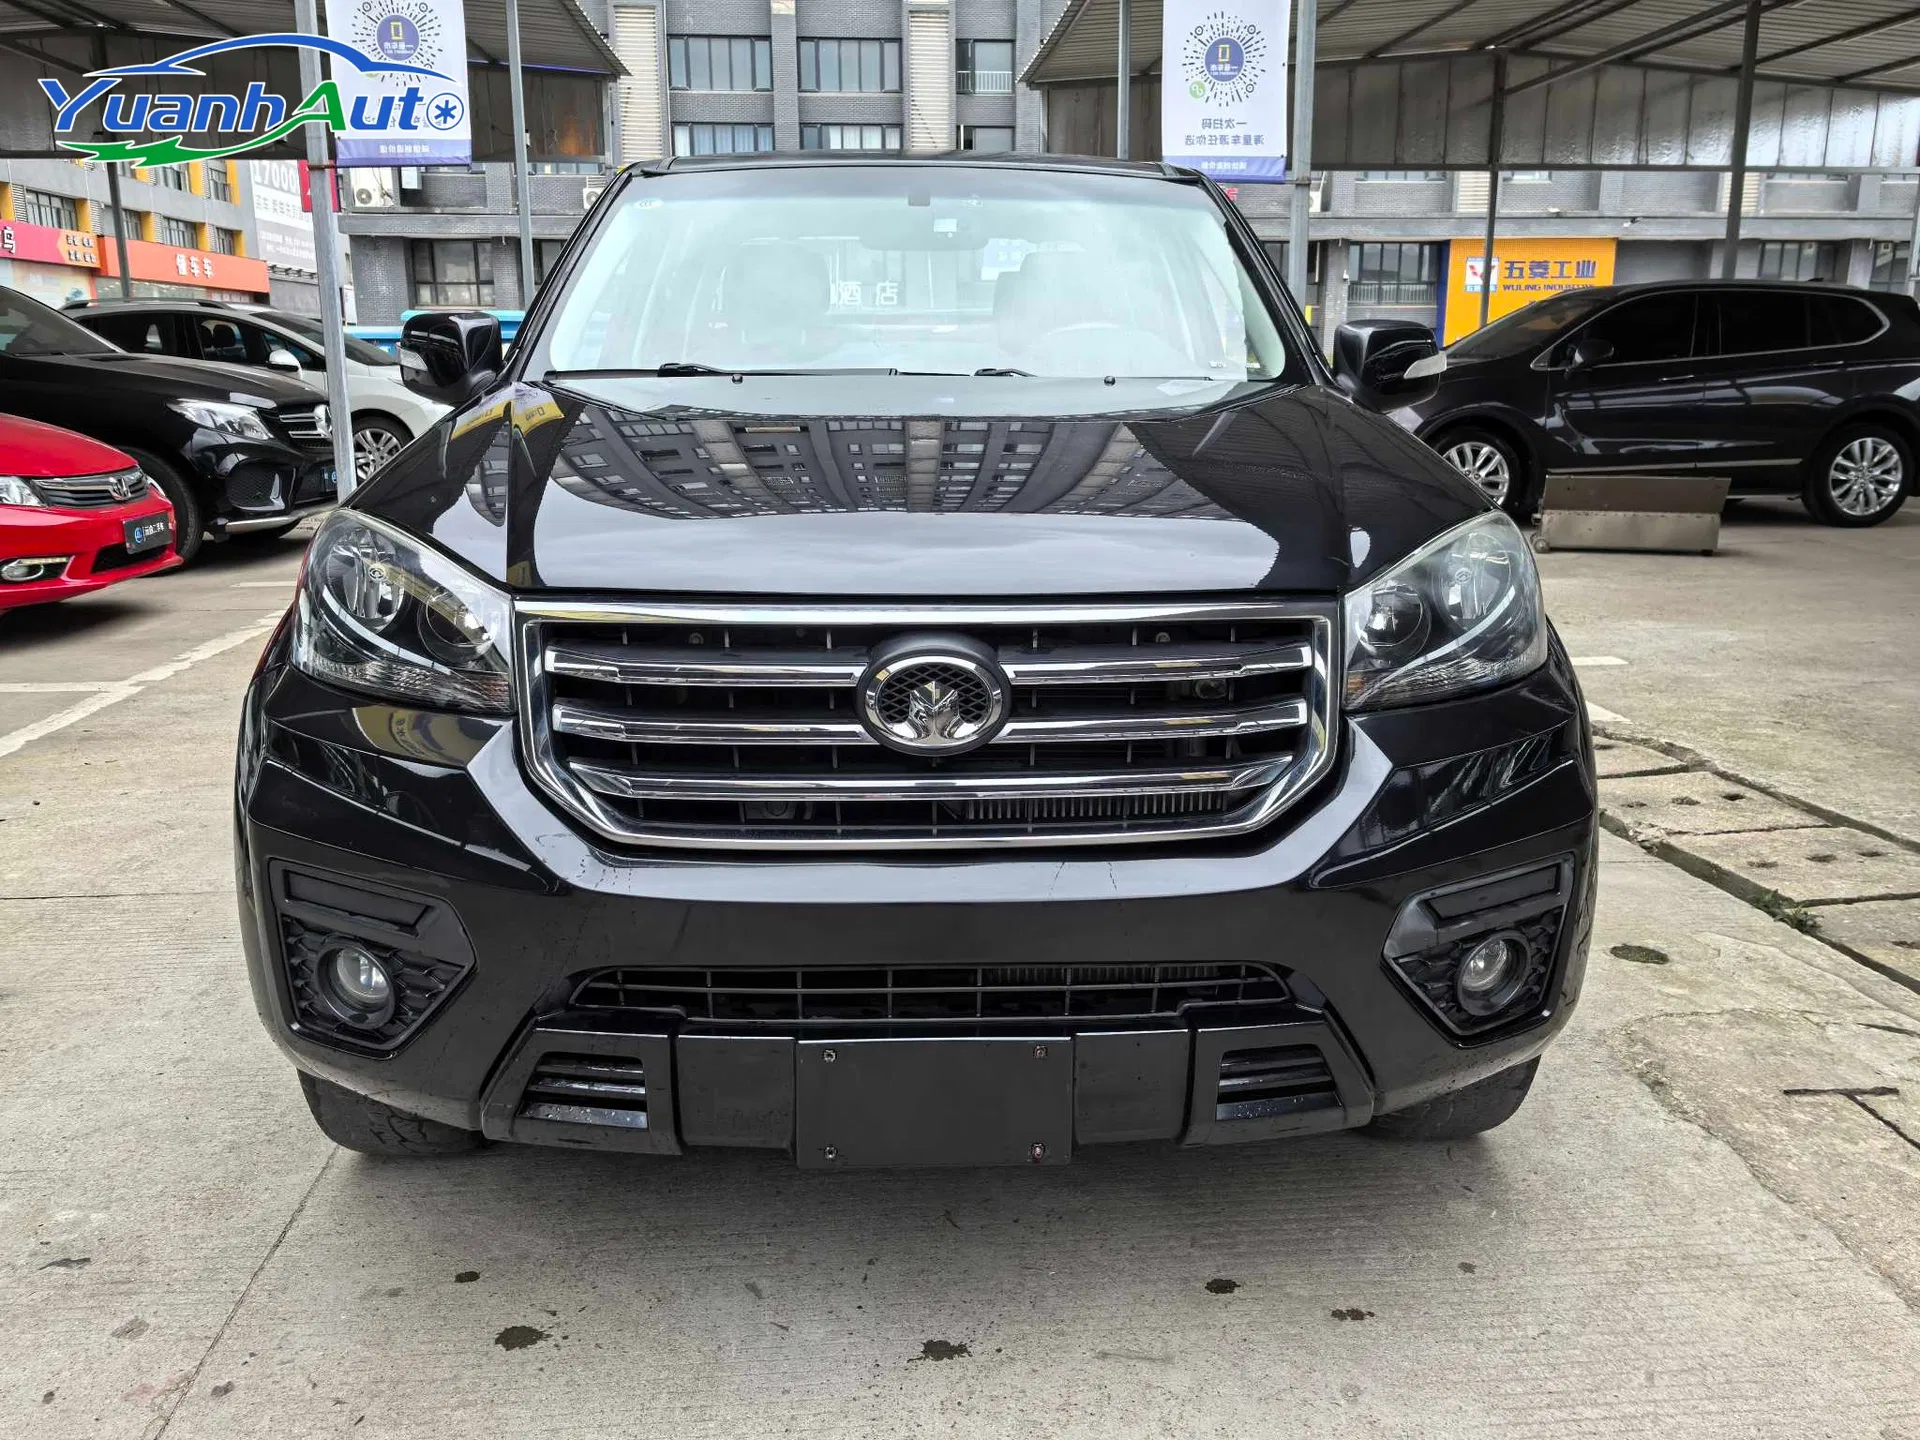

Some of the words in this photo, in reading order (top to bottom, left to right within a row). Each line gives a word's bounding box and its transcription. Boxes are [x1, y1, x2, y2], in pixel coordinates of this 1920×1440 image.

[0, 225, 16, 254] 鸟
[1503, 260, 1597, 279] 五菱工业
[1503, 284, 1541, 292] WULING
